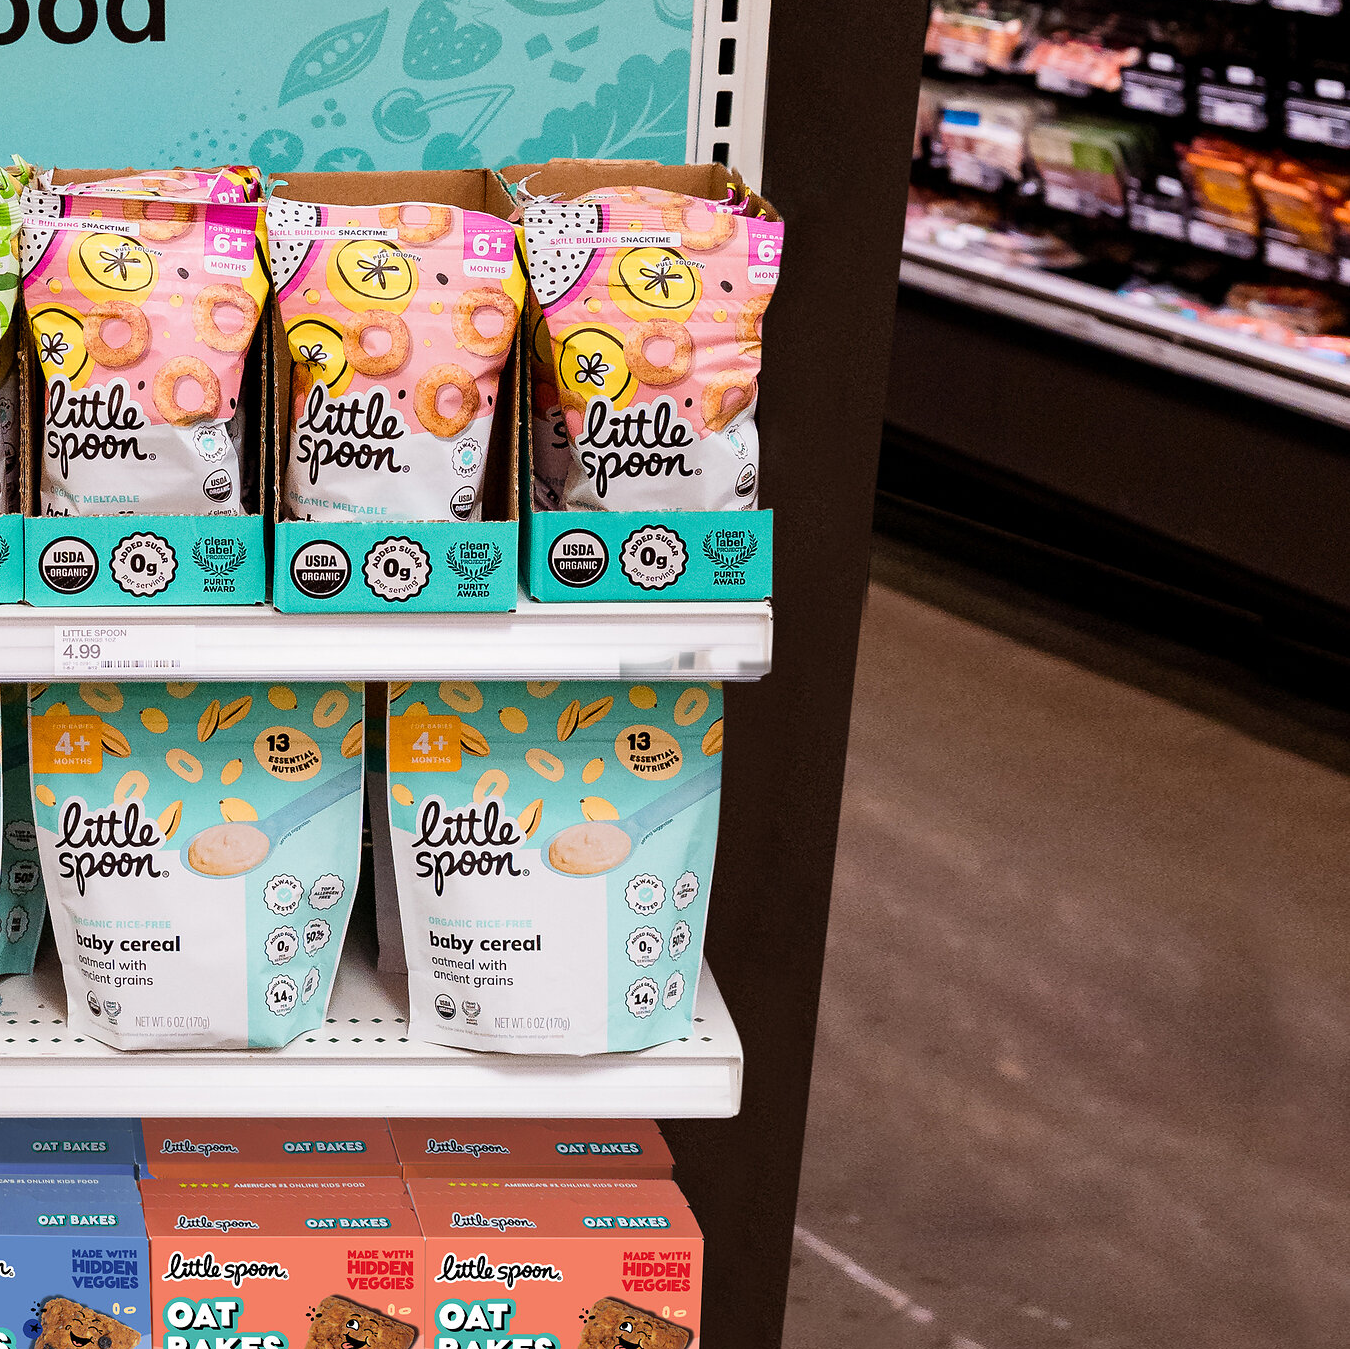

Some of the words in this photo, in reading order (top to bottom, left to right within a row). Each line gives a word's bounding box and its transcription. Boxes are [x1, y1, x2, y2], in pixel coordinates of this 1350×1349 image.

[213, 235, 248, 252] 6+
[210, 262, 247, 272] MONTHS
[63, 645, 101, 659] 4.99
[438, 1301, 509, 1332] OAT
